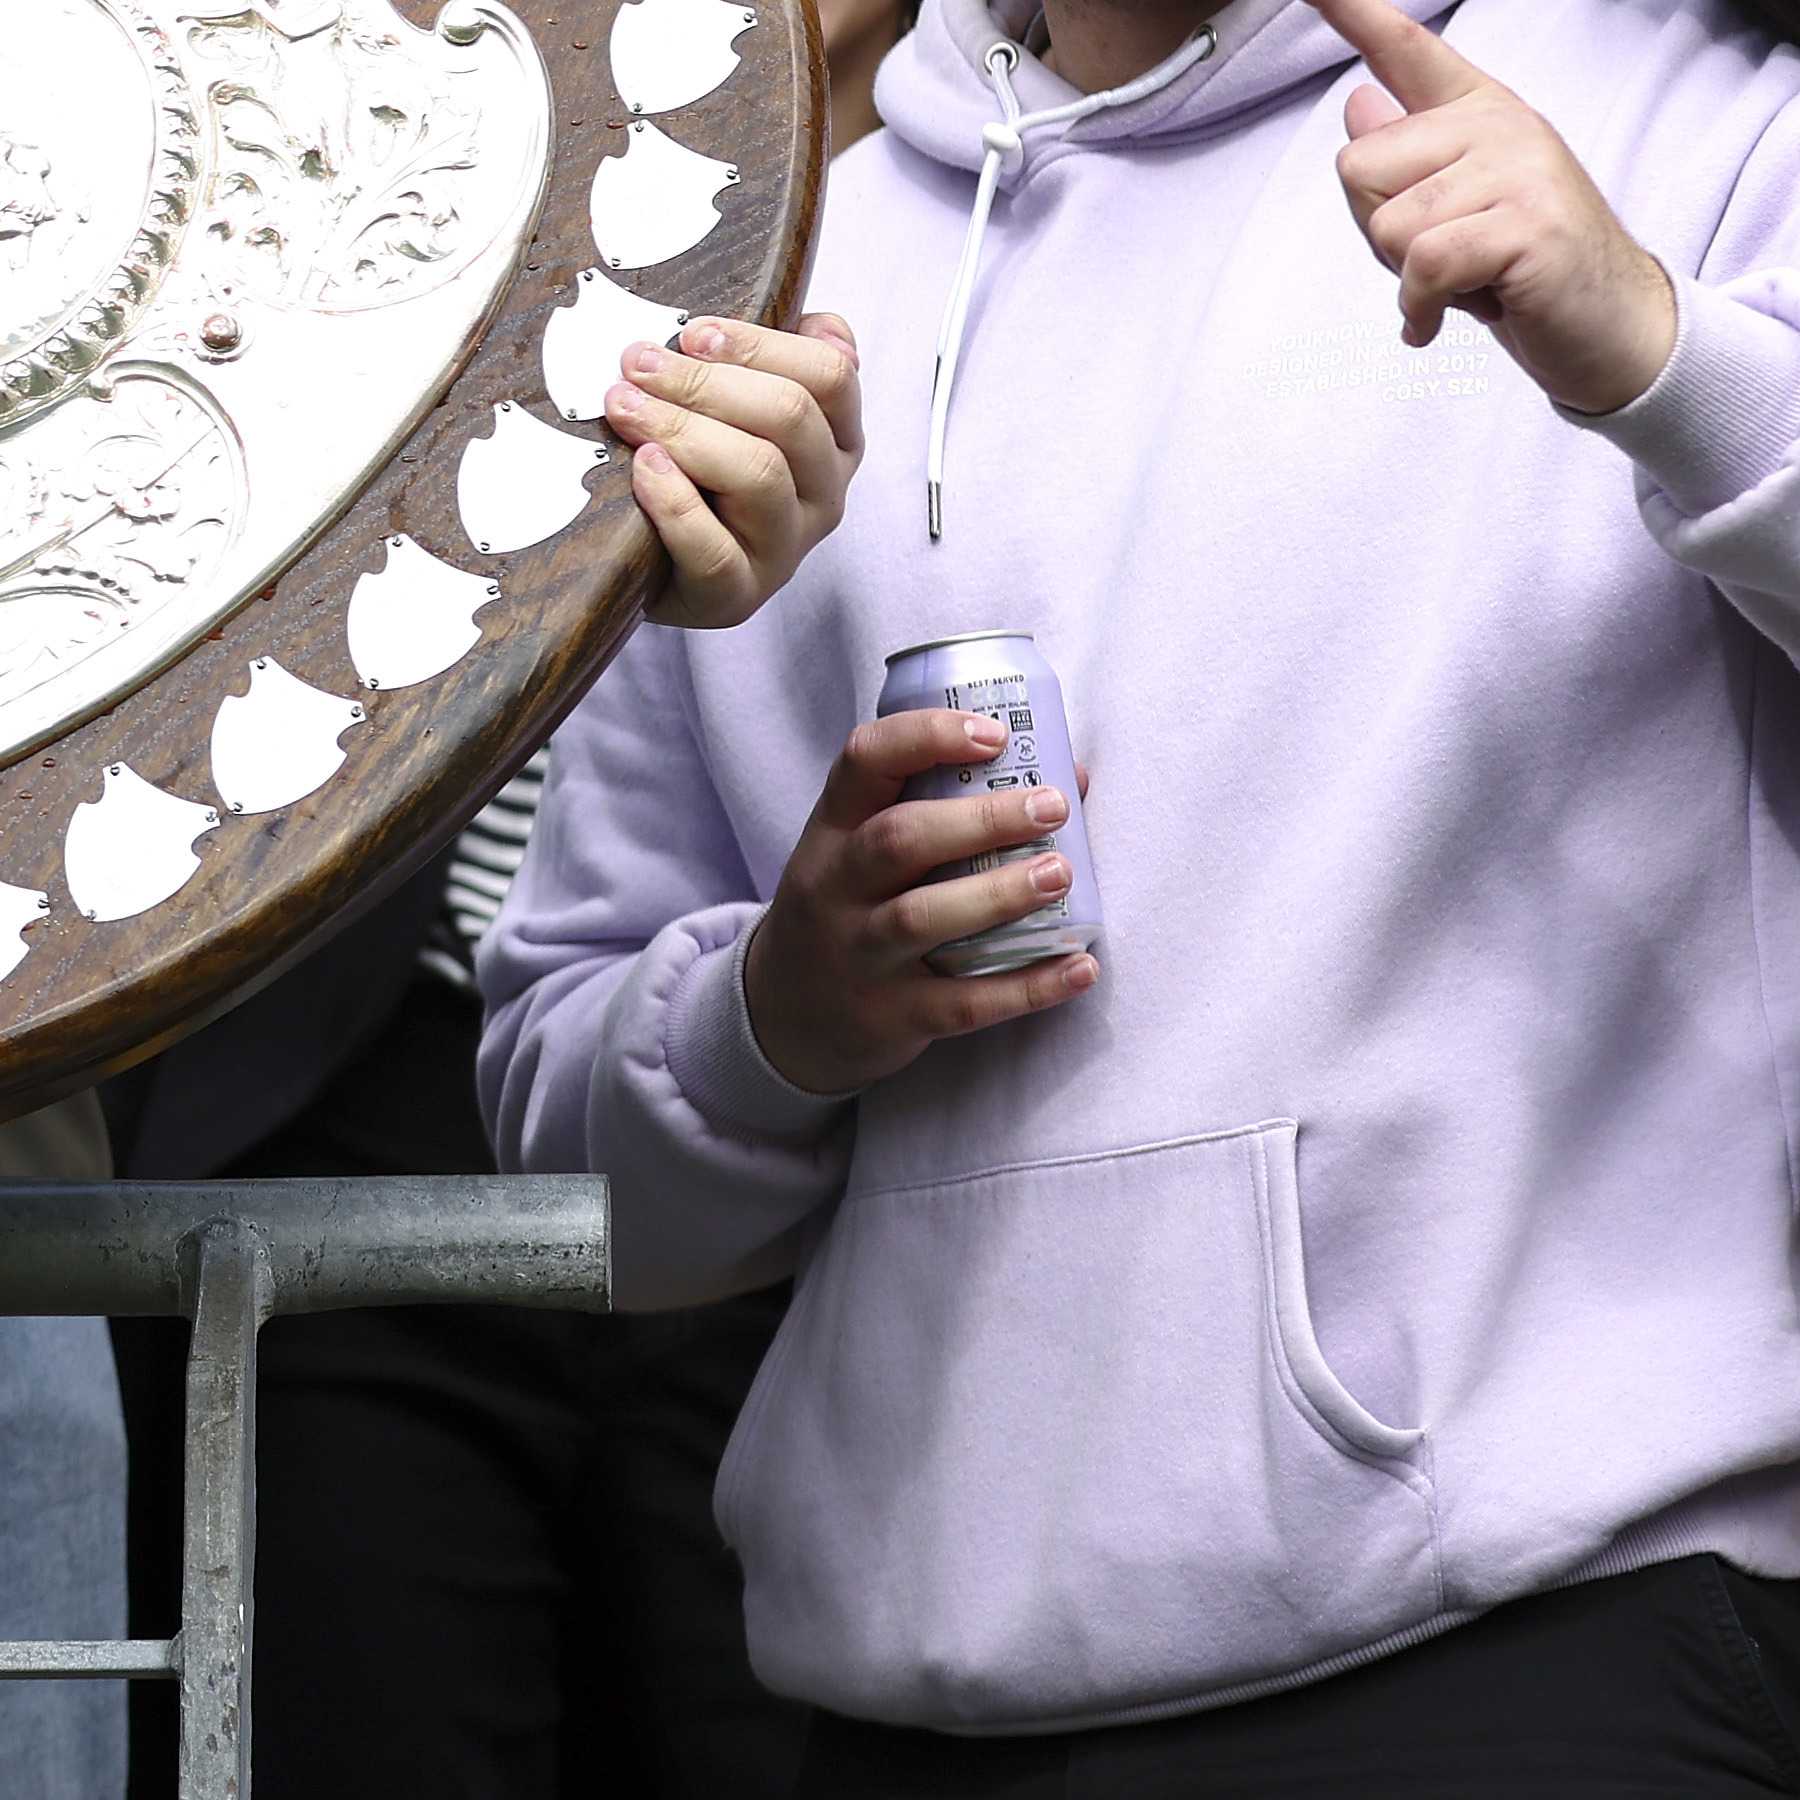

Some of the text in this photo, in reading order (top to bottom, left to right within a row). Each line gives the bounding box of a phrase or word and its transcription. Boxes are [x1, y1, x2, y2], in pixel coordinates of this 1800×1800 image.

[967, 674, 1024, 689] BEST SERVED
[971, 684, 1027, 703] COLD
